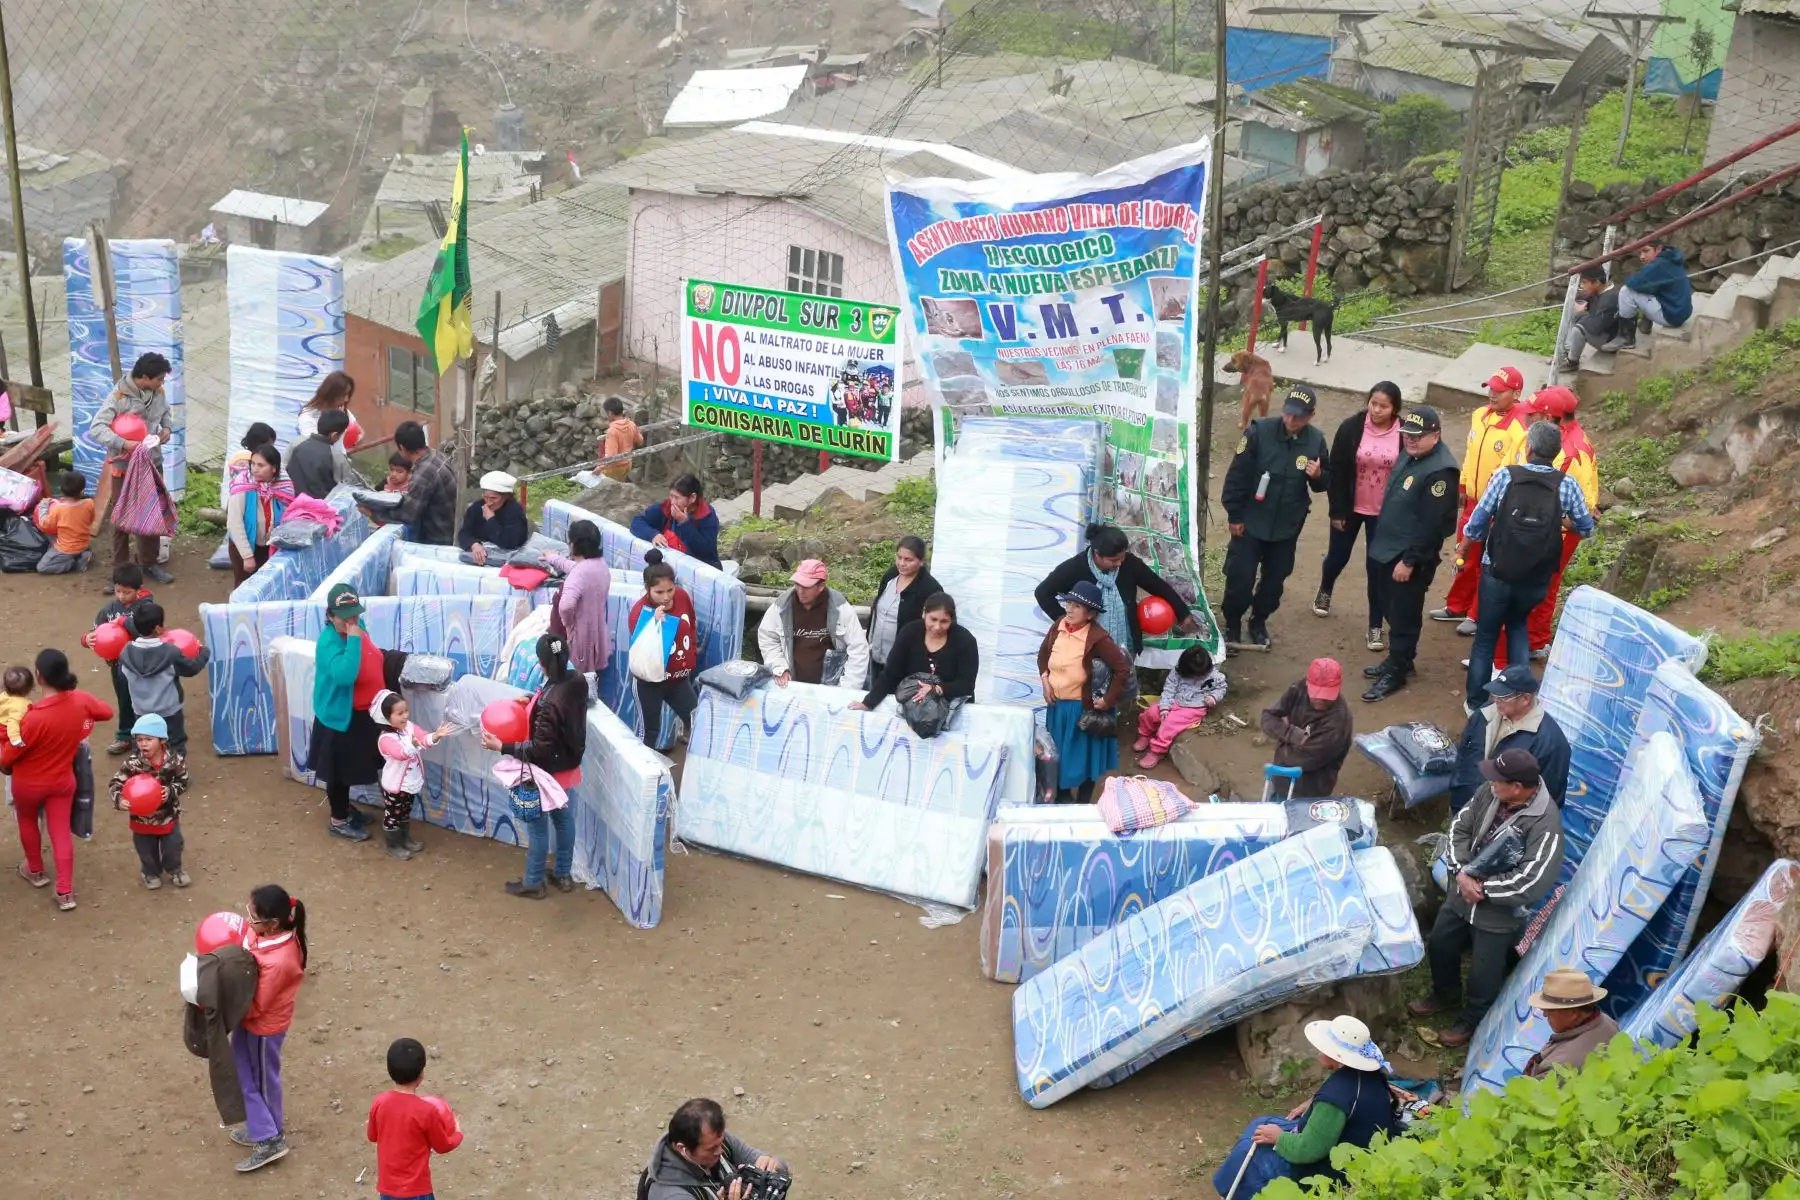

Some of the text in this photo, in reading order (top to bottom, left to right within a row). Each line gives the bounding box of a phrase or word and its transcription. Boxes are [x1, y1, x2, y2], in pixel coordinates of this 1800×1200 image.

[908, 201, 1199, 265] ASENTAMIENTO HUMANO VILLA DE LOURES
[1001, 234, 1114, 265] ECOLOGICO
[940, 247, 1179, 294] ZONA 4 NUEVA ESPERANZA
[721, 290, 862, 333] DIVPOL SUR 3
[692, 320, 741, 386] NO
[744, 330, 884, 361] AL MALTRATO DE LA MUJER
[998, 331, 1151, 358] NUESTROS VECINOS EN PLENA FAENA
[744, 353, 841, 379] AL ABUSO INFANTIL
[1056, 359, 1073, 371] LAS
[712, 386, 750, 406] VIVA
[752, 394, 773, 410] LA
[777, 398, 808, 417] PAZ
[744, 375, 814, 397] A LAS DROGAS
[1010, 387, 1050, 398] SENTIMOS
[1050, 382, 1101, 397] ORGULLOSOS
[1102, 380, 1113, 391] DE
[693, 403, 886, 456] COMISARIA DE LURÍN
